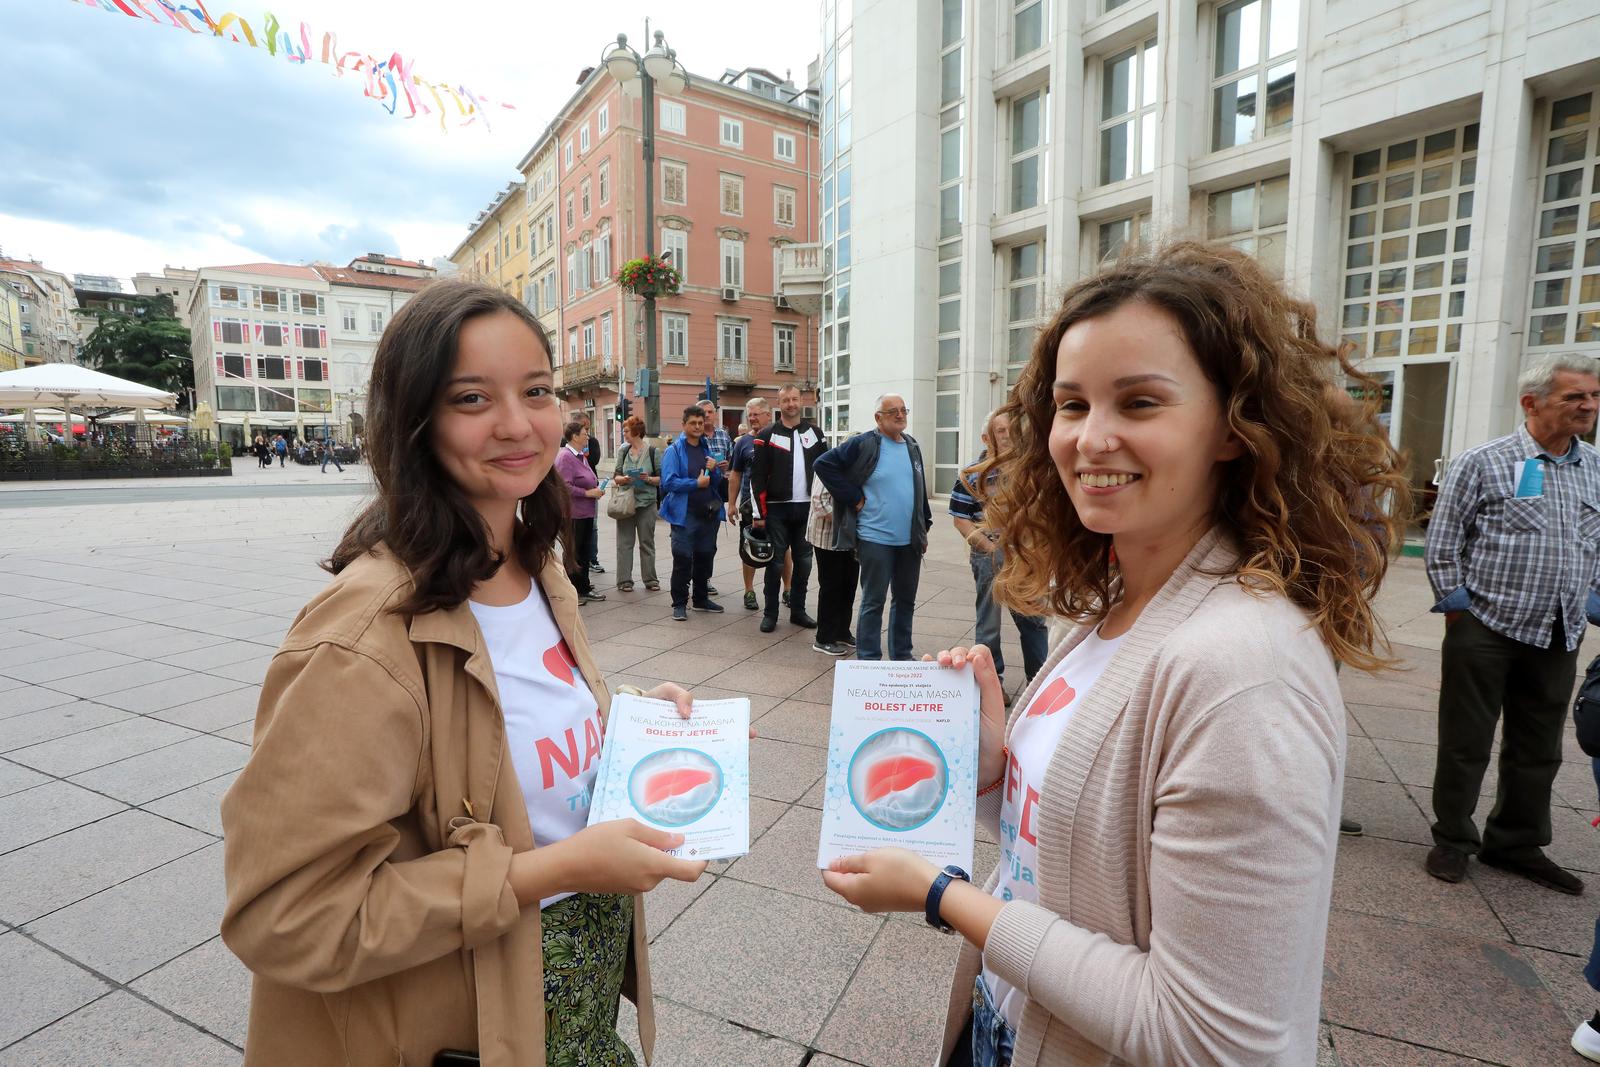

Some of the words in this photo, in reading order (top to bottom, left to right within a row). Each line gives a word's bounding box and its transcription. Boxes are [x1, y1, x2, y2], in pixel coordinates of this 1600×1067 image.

[847, 688, 923, 699] NEALKOHOLNA
[926, 690, 962, 699] MASNA
[864, 702, 907, 712] BOLEST
[909, 703, 943, 712] JETRE
[630, 715, 699, 728] NEALKOHOLNA
[702, 717, 735, 728] MASNA
[645, 728, 684, 737] BOLEST
[687, 728, 719, 737] JETRE
